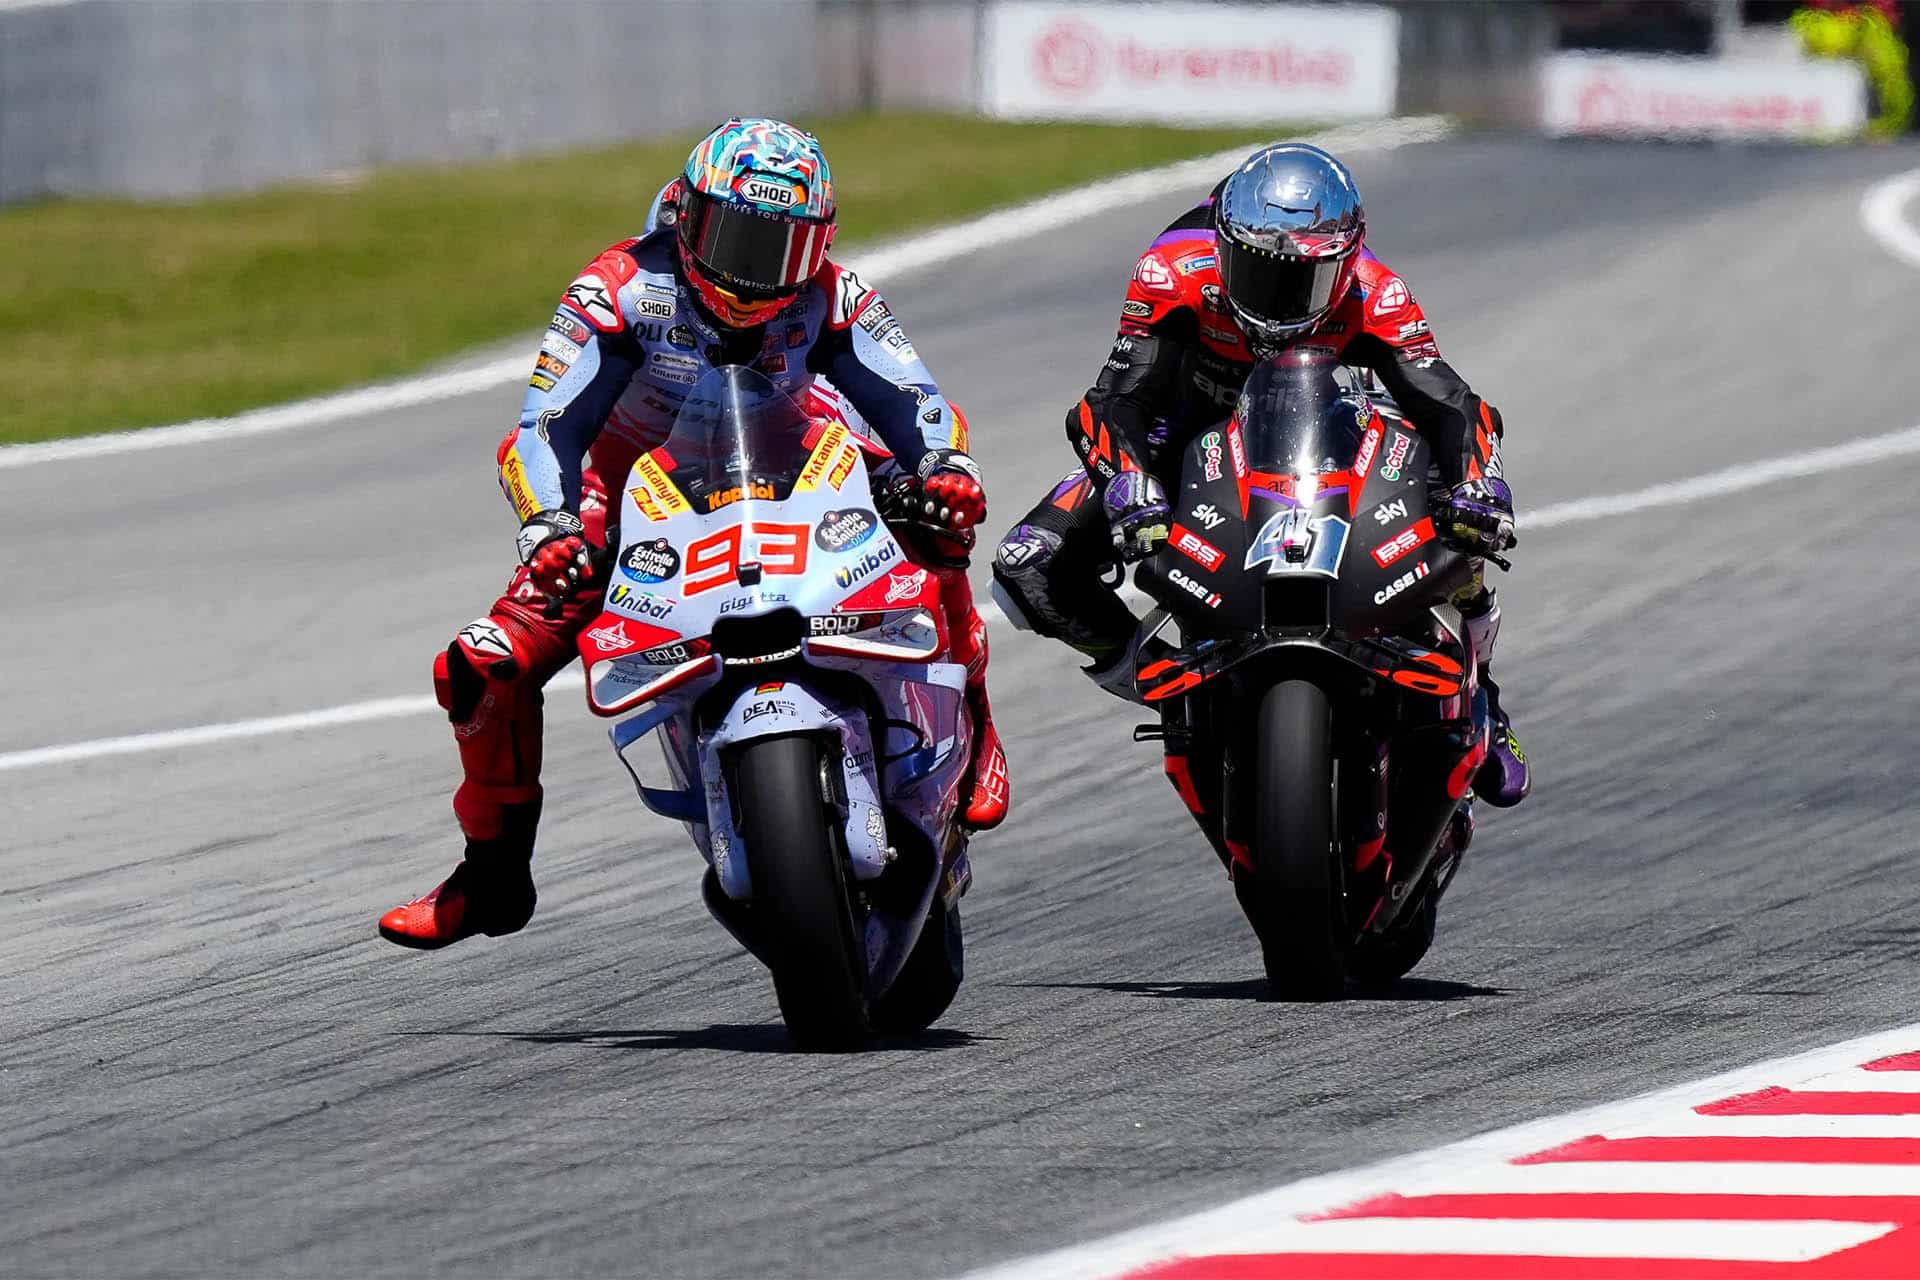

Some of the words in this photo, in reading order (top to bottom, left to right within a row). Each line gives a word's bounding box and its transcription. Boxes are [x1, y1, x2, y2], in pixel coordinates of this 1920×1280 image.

[748, 183, 791, 205] SHOEI
[733, 276, 777, 291] VERTICAL
[641, 301, 671, 318] SHOEI
[858, 303, 886, 327] BOLD
[801, 424, 846, 487] Antangin
[640, 459, 681, 509] Antangin
[706, 484, 776, 511] Kapiol
[821, 511, 863, 540] Estrella
[1191, 503, 1226, 530] sky
[1374, 498, 1408, 526] sky
[830, 520, 871, 547] Galicia
[1244, 506, 1352, 580] 41
[1375, 528, 1418, 561] BS
[632, 545, 676, 567] Estrella
[682, 522, 812, 600] 93
[1179, 533, 1220, 563] BS
[628, 558, 667, 579] Galicia
[835, 539, 897, 589] Unibat
[1167, 569, 1208, 600] CASE
[1374, 571, 1416, 605] CASE
[608, 585, 674, 620] Unibat
[809, 616, 859, 631] BOLD
[644, 645, 687, 664] BOLD
[743, 700, 778, 720] DEA
